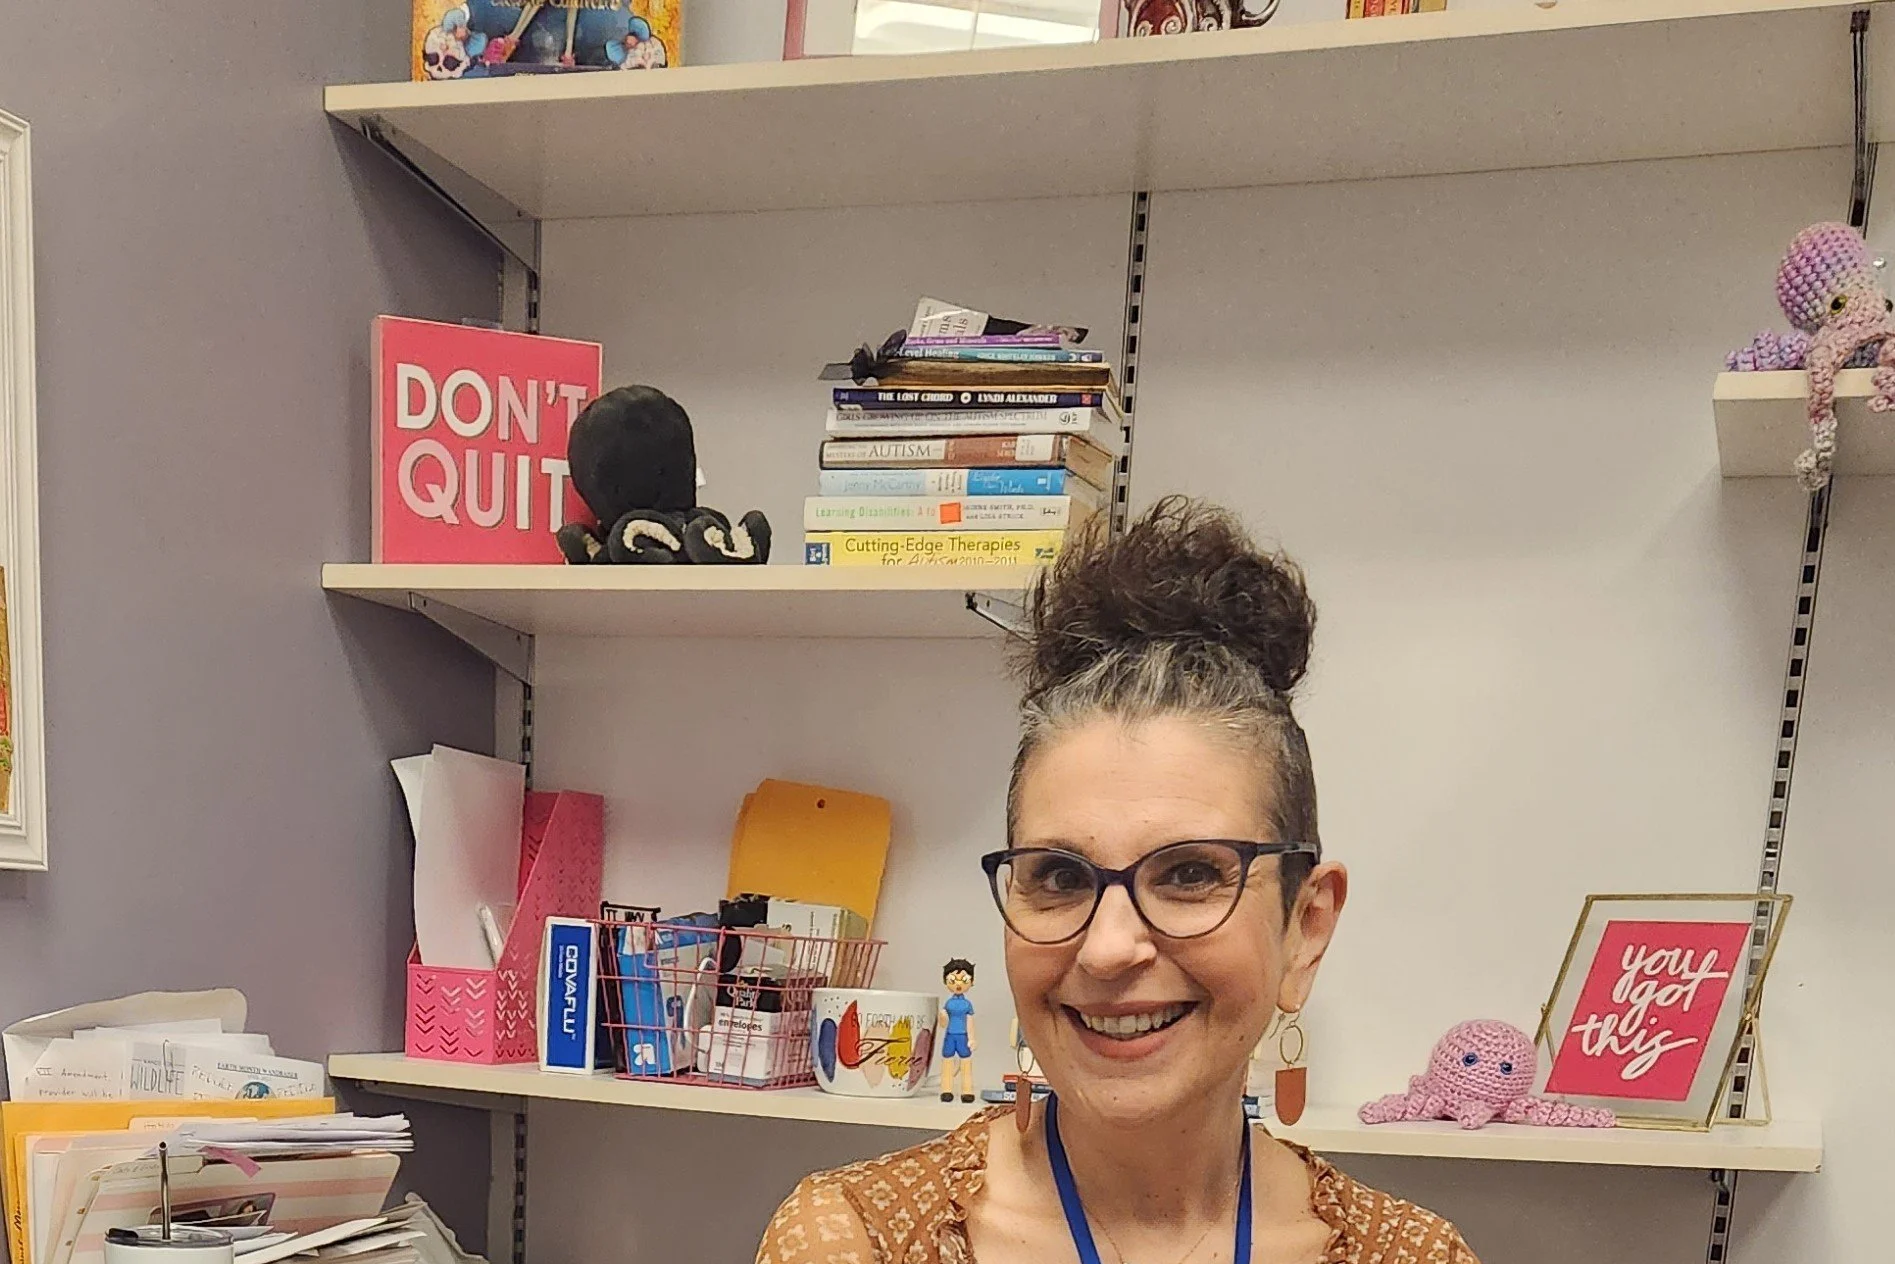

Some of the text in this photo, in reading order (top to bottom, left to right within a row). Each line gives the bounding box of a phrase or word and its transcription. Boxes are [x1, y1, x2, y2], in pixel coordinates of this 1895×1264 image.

[396, 362, 588, 444] DON'T
[878, 392, 1059, 404] THE LOST CHORD LYNDI ALEXANDER
[868, 444, 931, 458] AUTISM
[398, 438, 571, 533] QUIT
[816, 506, 855, 519] Learning
[845, 537, 944, 555] Cutting-Edge
[948, 536, 1021, 555] Therapies
[882, 553, 902, 565] for
[1612, 944, 1695, 1004] you
[563, 945, 578, 1034] COVAFLU
[1618, 949, 1729, 1037] got
[718, 1019, 763, 1032] envelopes
[866, 1013, 895, 1028] FORTH
[1571, 1013, 1699, 1081] this
